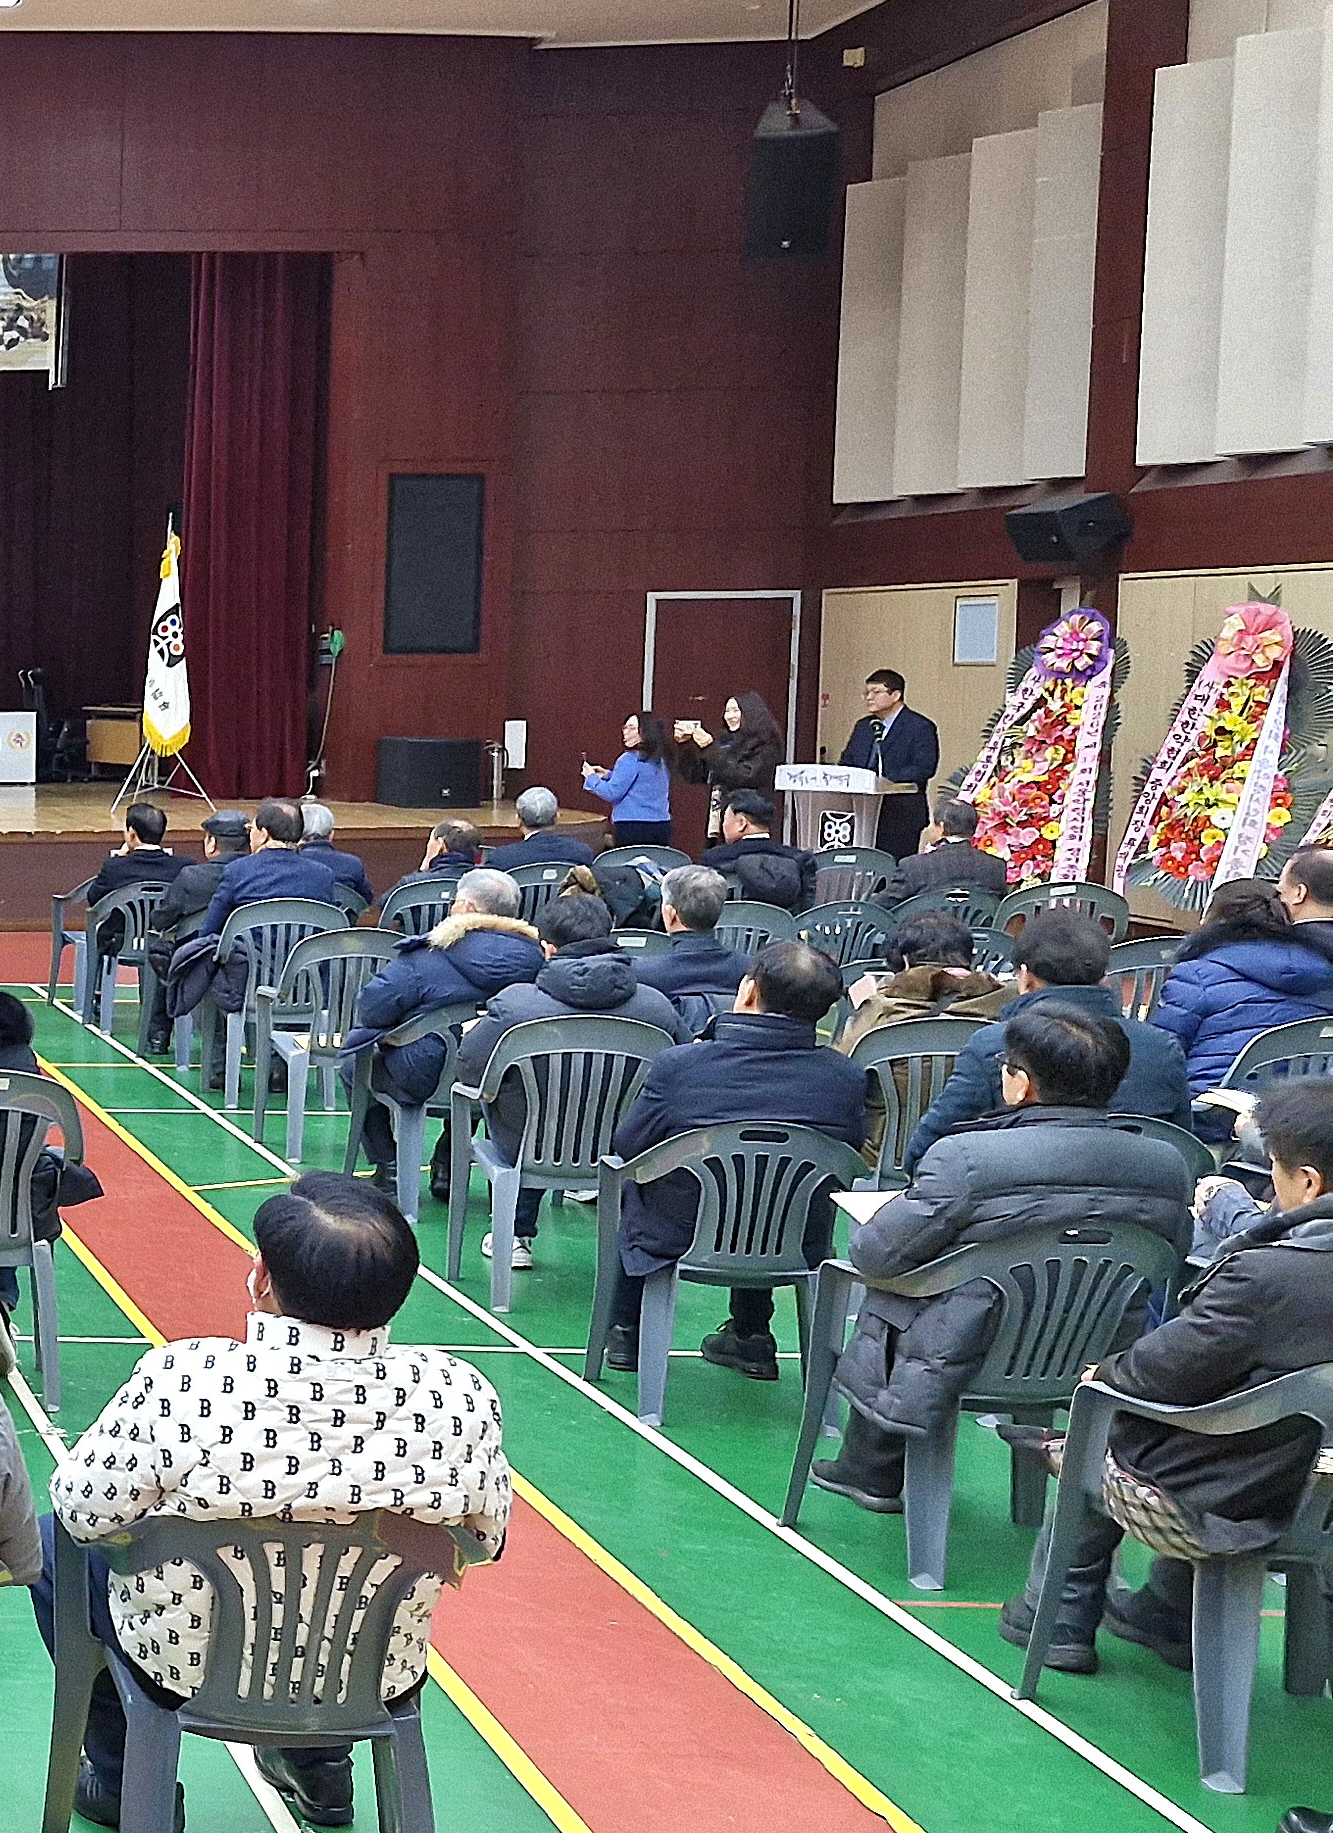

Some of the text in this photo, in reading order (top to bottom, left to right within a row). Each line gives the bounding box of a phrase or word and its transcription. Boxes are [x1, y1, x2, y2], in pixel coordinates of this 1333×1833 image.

[257, 1322, 265, 1341] B
[287, 1326, 300, 1346] B
[331, 1333, 345, 1352] B
[369, 1337, 377, 1356] B
[163, 1355, 174, 1369] B
[204, 1355, 215, 1369] B
[247, 1355, 256, 1372] B
[288, 1356, 302, 1374] B
[374, 1362, 387, 1380] B
[180, 1375, 191, 1392] B
[410, 1365, 420, 1384] B
[222, 1376, 234, 1394] B
[265, 1378, 278, 1398] B
[310, 1382, 324, 1401] B
[472, 1378, 482, 1391] B
[354, 1385, 367, 1404] B
[394, 1387, 406, 1407] B
[429, 1390, 443, 1409] B
[464, 1394, 475, 1412] B
[159, 1398, 171, 1417] B
[199, 1399, 211, 1418] B
[242, 1401, 256, 1420] B
[286, 1405, 301, 1424] B
[331, 1409, 346, 1427] B
[374, 1411, 387, 1431] B
[413, 1413, 426, 1433] B
[452, 1416, 462, 1436] B
[179, 1424, 191, 1443] B
[219, 1425, 233, 1444] B
[264, 1428, 277, 1448] B
[309, 1432, 322, 1452] B
[351, 1436, 364, 1454] B
[395, 1438, 407, 1458] B
[432, 1441, 443, 1460] B
[160, 1449, 173, 1468] B
[240, 1452, 254, 1472] B
[285, 1455, 300, 1475] B
[329, 1458, 342, 1476] B
[373, 1461, 386, 1481] B
[412, 1464, 425, 1484] B
[448, 1467, 458, 1487] B
[478, 1471, 486, 1490] B
[218, 1475, 231, 1495] B
[262, 1480, 276, 1499] B
[305, 1482, 318, 1499] B
[348, 1485, 361, 1504] B
[390, 1488, 405, 1508] B
[426, 1492, 441, 1510] B
[461, 1495, 471, 1515] B
[240, 1502, 254, 1518] B
[275, 1549, 288, 1569] B
[191, 1574, 204, 1590] B
[337, 1574, 351, 1593] B
[171, 1591, 183, 1606] B
[357, 1593, 370, 1612] B
[189, 1612, 202, 1629] B
[168, 1628, 179, 1645] B
[137, 1642, 148, 1660] B
[189, 1652, 201, 1666] B
[168, 1665, 180, 1680] B
